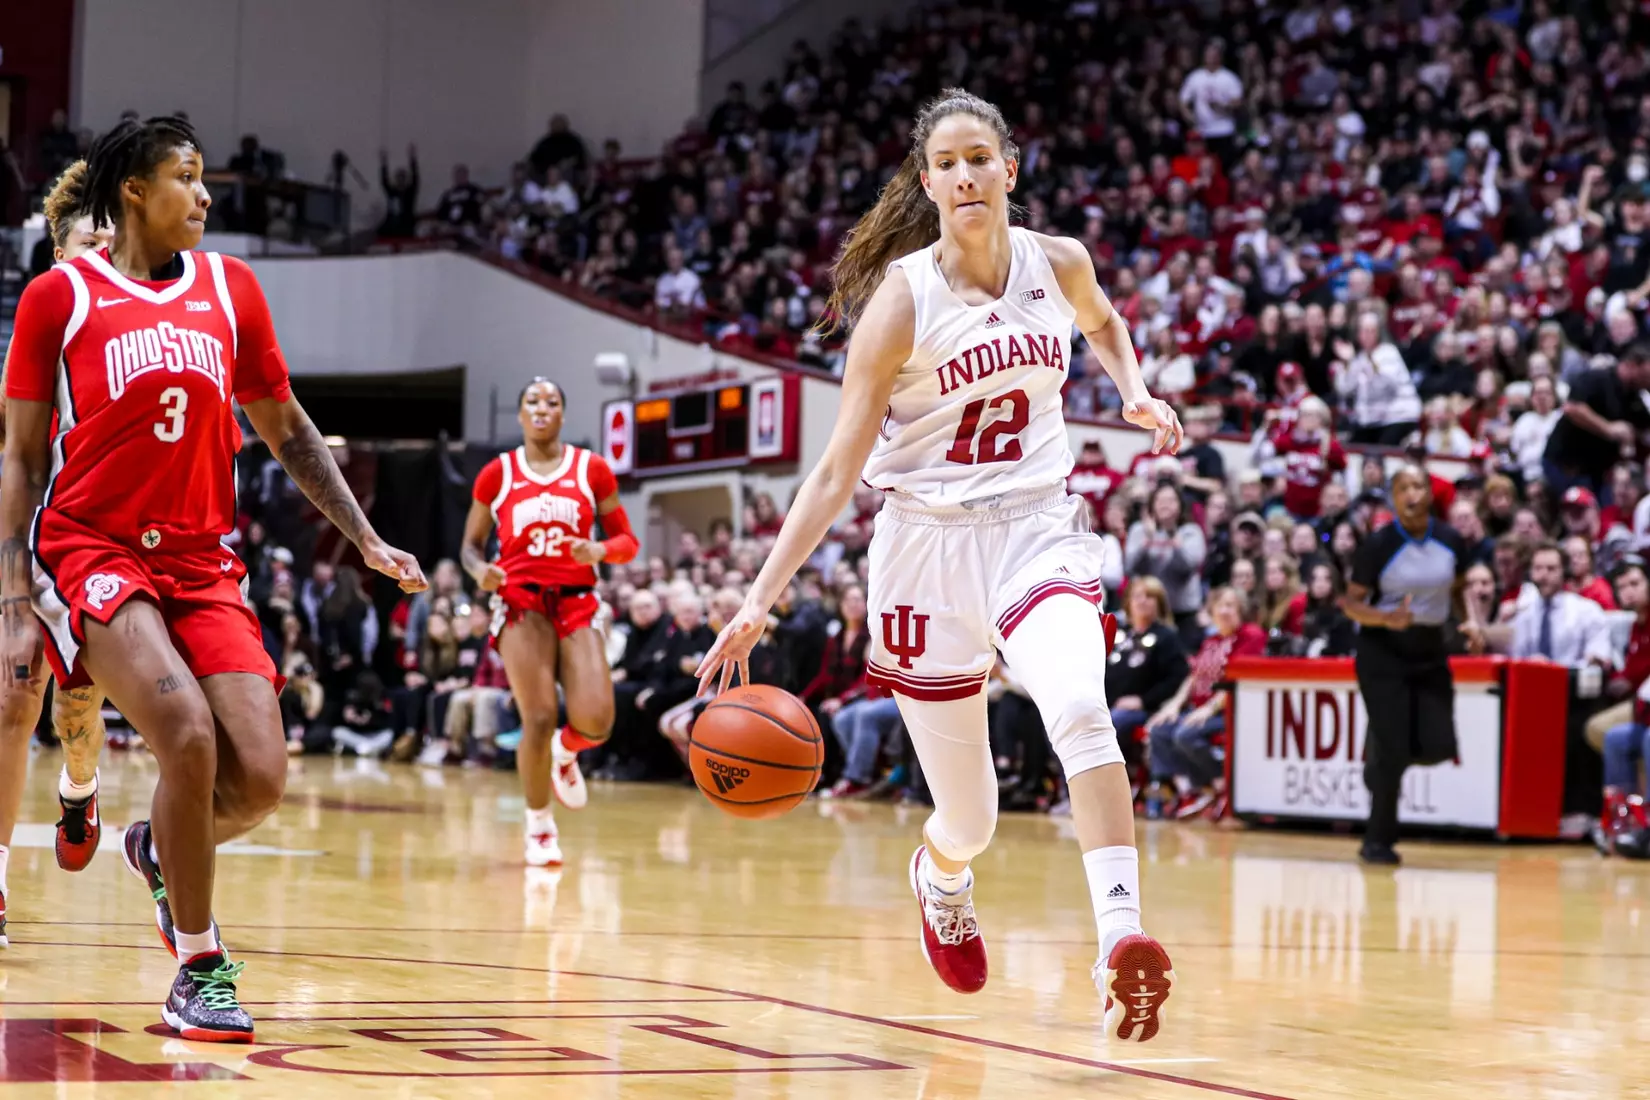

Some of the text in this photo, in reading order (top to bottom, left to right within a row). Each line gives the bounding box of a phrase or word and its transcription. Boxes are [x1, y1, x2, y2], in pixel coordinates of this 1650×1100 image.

[985, 320, 1006, 330] adidas
[936, 333, 1065, 396] INDIANA
[153, 387, 189, 443] 3
[945, 388, 1030, 465] 12
[527, 526, 564, 557] 32
[706, 758, 751, 779] adidas
[1284, 764, 1440, 814] BASKELL
